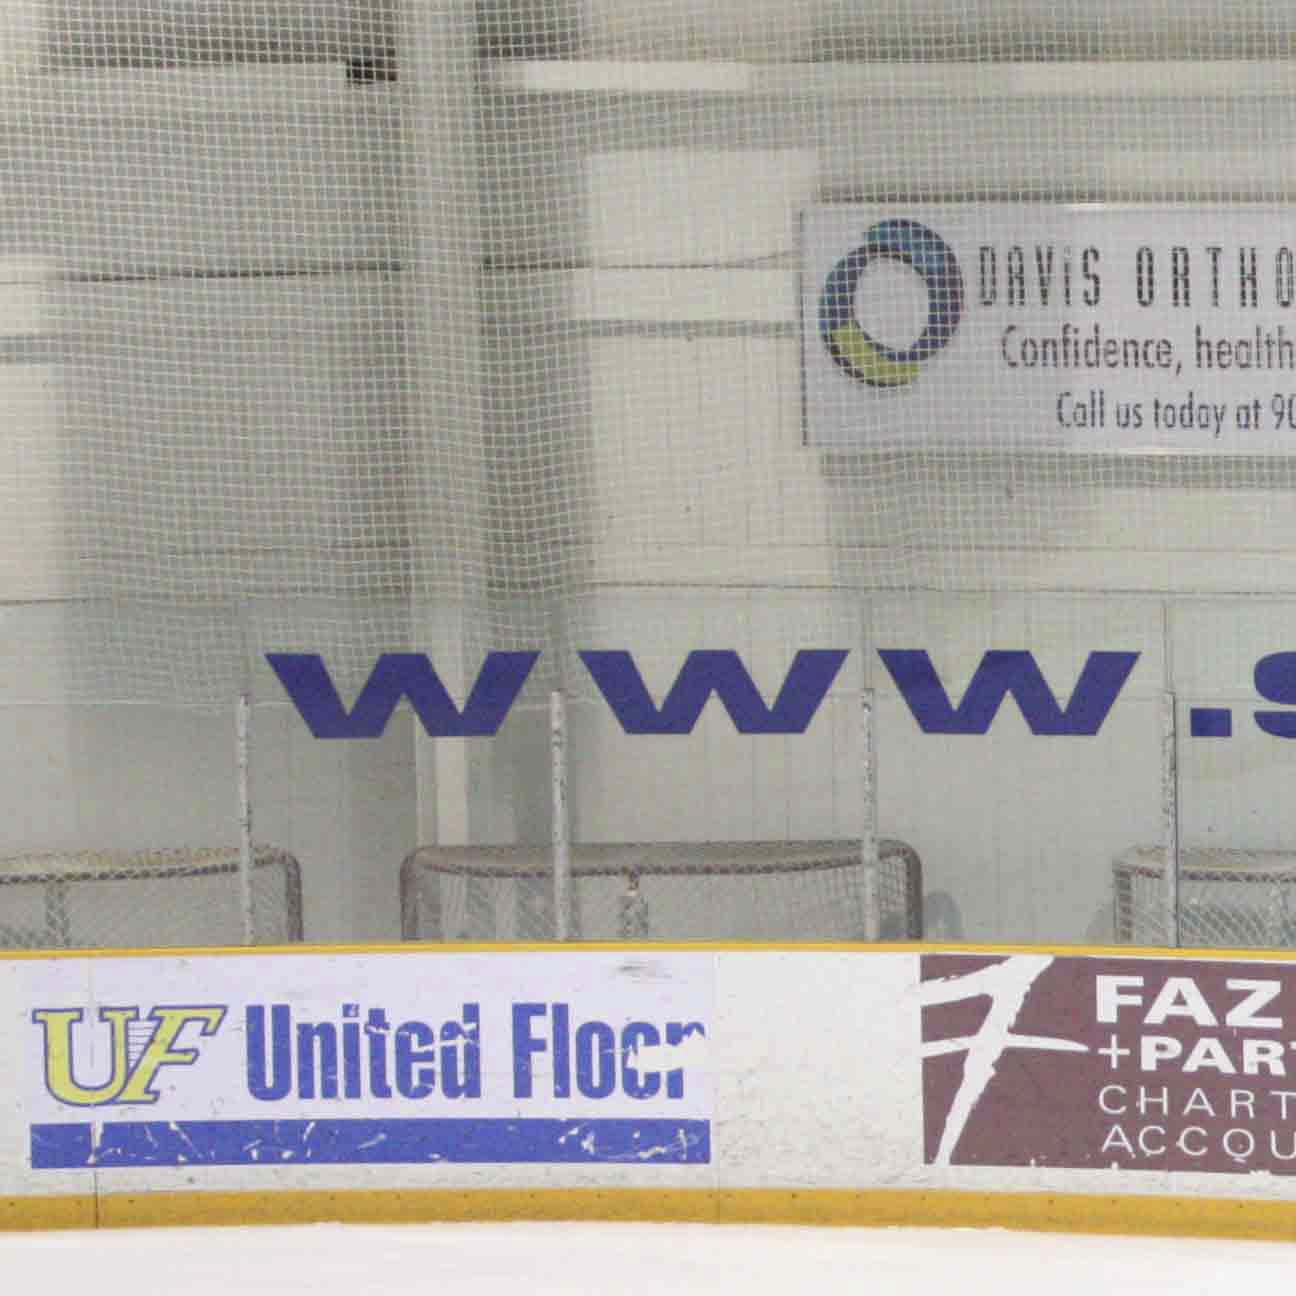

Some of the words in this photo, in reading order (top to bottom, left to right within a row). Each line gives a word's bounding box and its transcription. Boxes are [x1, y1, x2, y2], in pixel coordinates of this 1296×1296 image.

[1001, 323, 1182, 376] Confidence,
[1056, 390, 1105, 428] Call
[1116, 402, 1143, 429] us
[1153, 391, 1227, 438] today
[1236, 398, 1262, 431] at
[32, 1003, 227, 1106] UF
[245, 1003, 480, 1101] United
